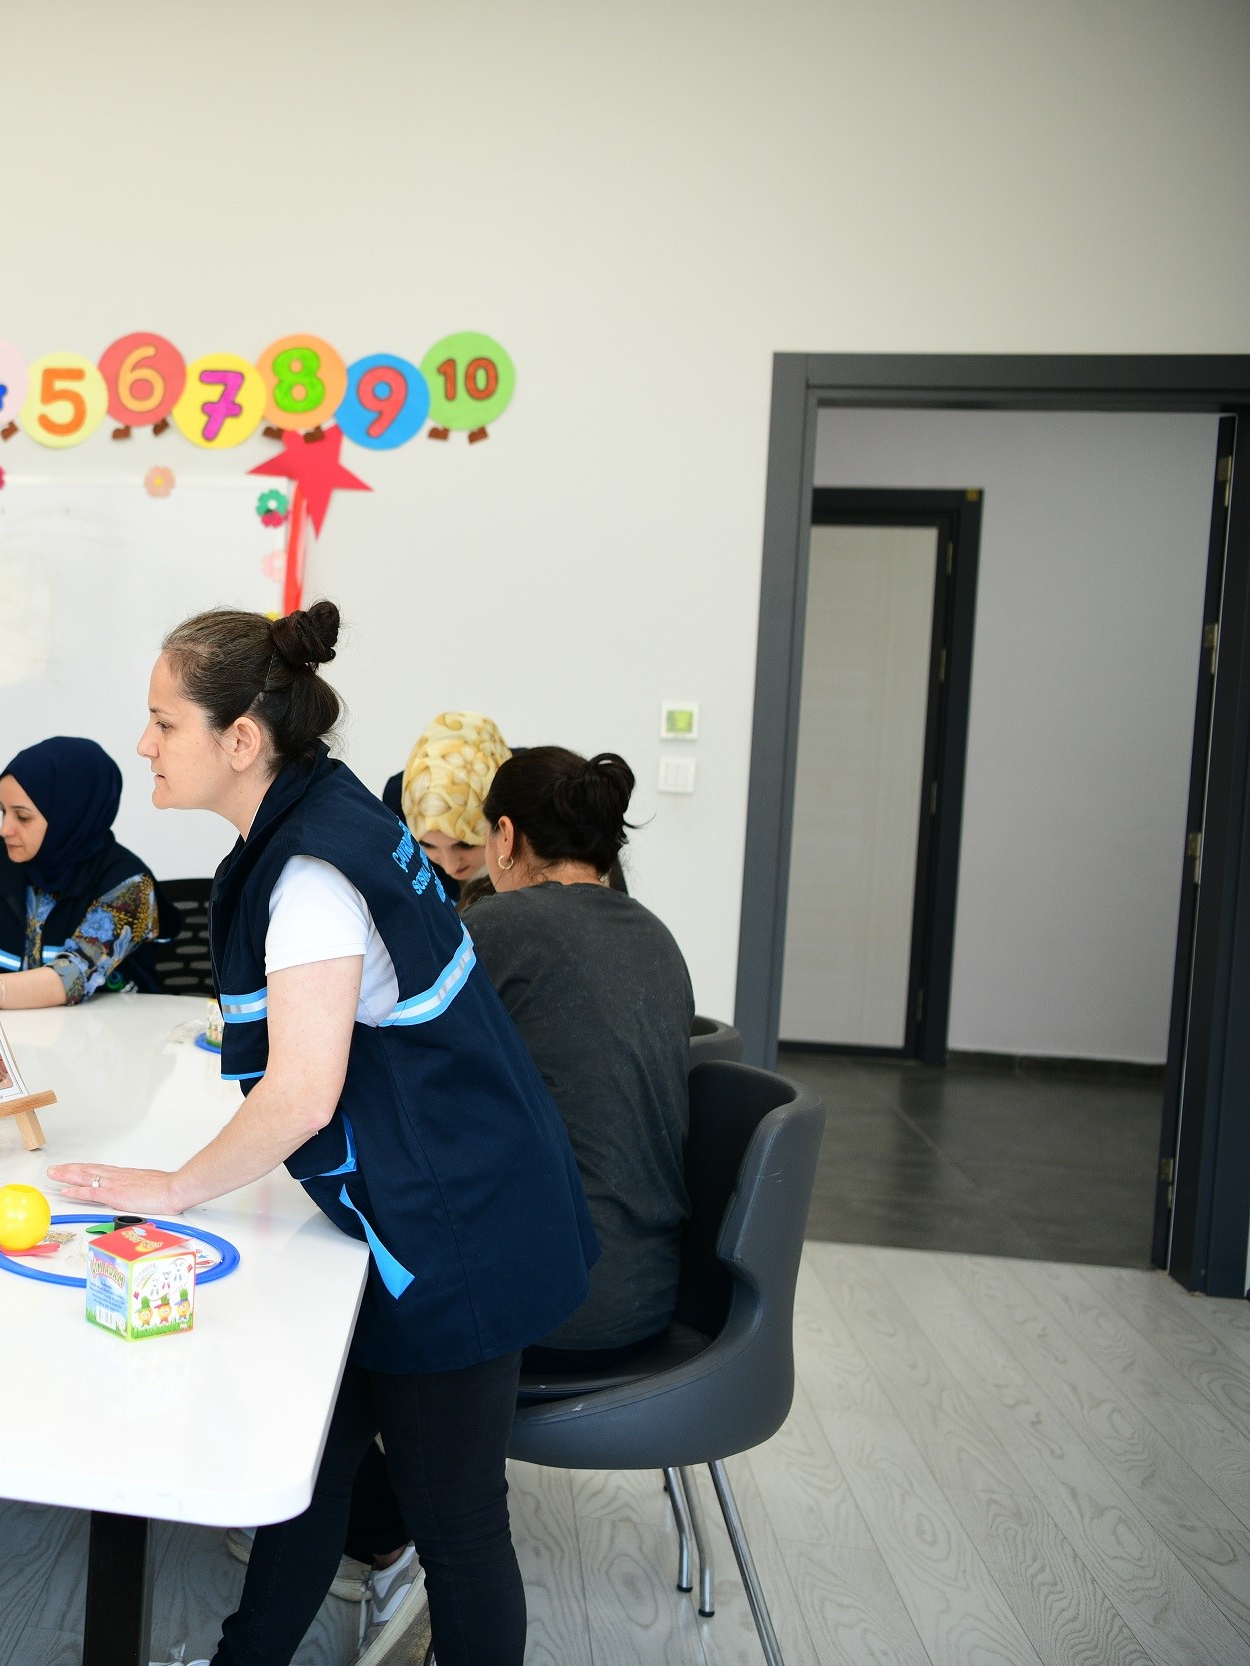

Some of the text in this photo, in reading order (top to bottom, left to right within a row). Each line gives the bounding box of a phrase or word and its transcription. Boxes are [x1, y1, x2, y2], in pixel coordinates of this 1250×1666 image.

[38, 367, 88, 437] 5
[117, 345, 166, 413] 6
[199, 370, 244, 441] 7
[272, 347, 326, 414] 8
[356, 366, 408, 438] 9
[437, 357, 498, 401] 10
